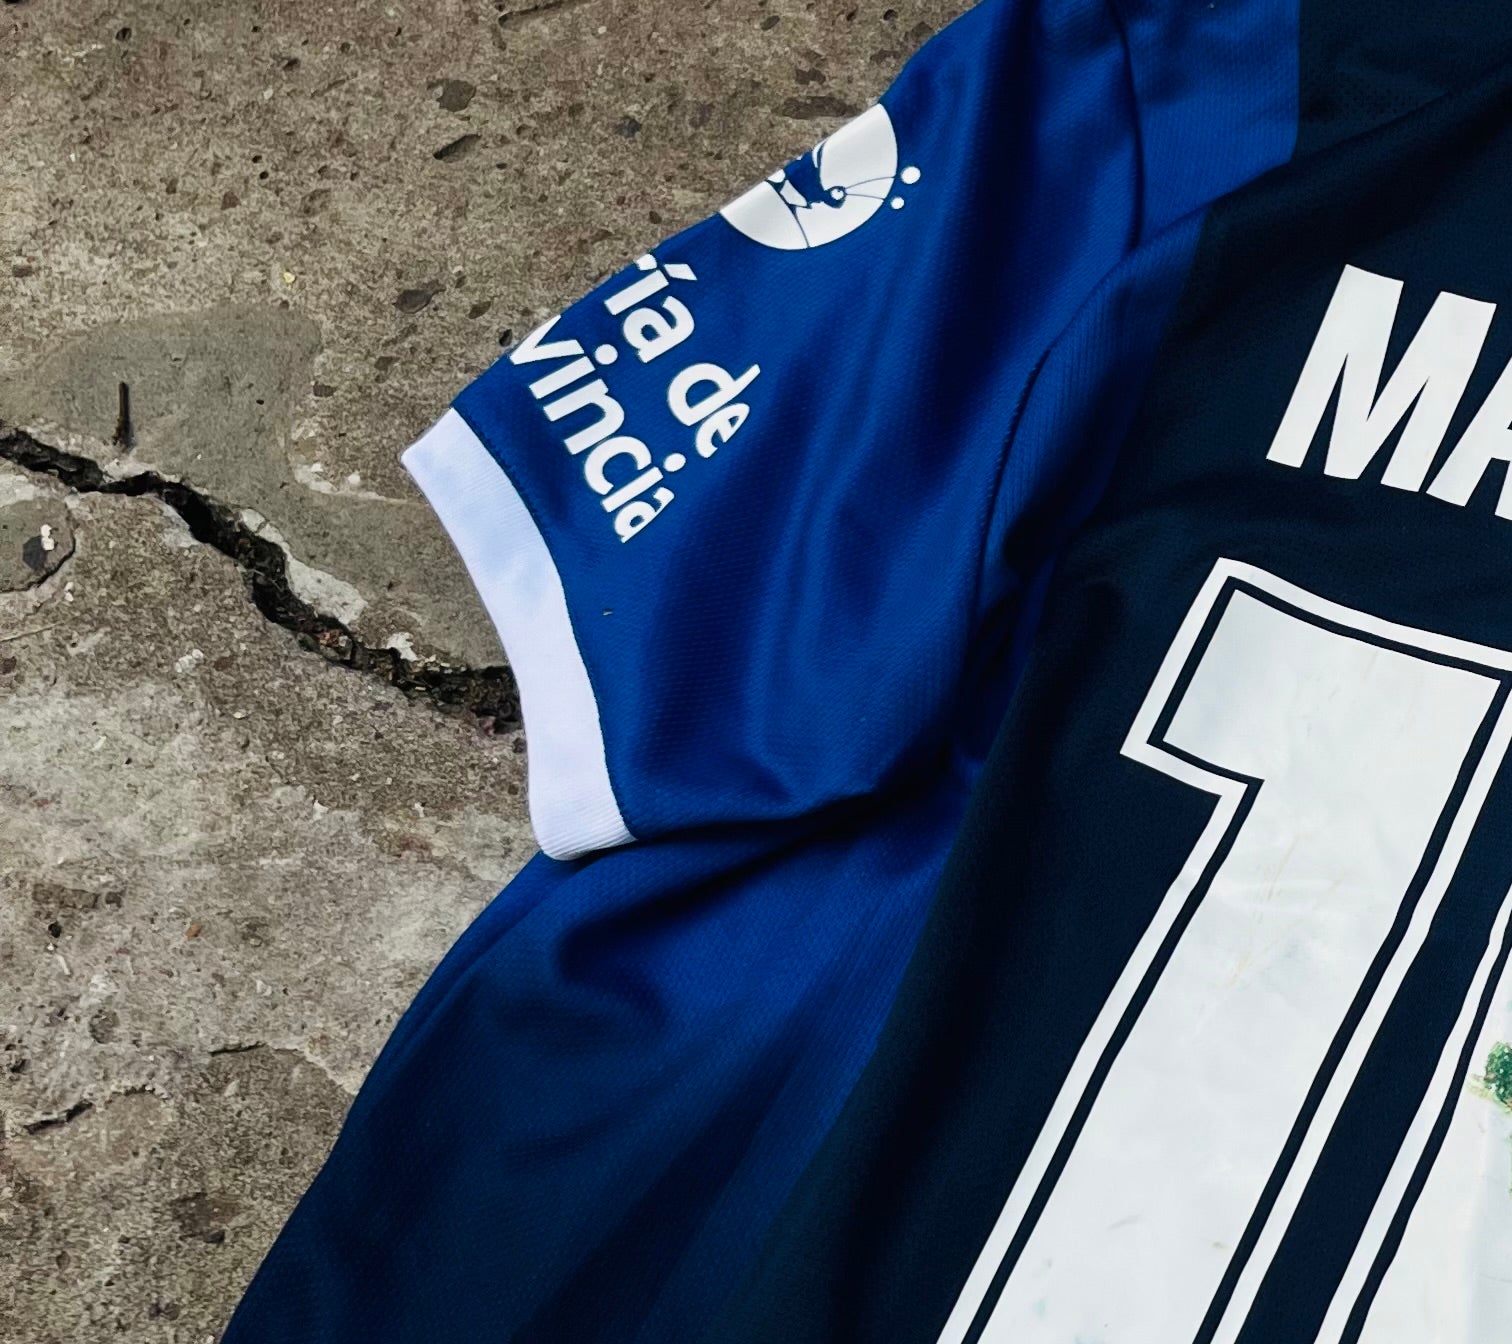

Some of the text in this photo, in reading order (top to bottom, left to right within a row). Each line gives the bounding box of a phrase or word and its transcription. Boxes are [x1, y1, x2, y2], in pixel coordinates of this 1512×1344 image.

[509, 314, 686, 543] vincia
[604, 253, 761, 458] ía de
